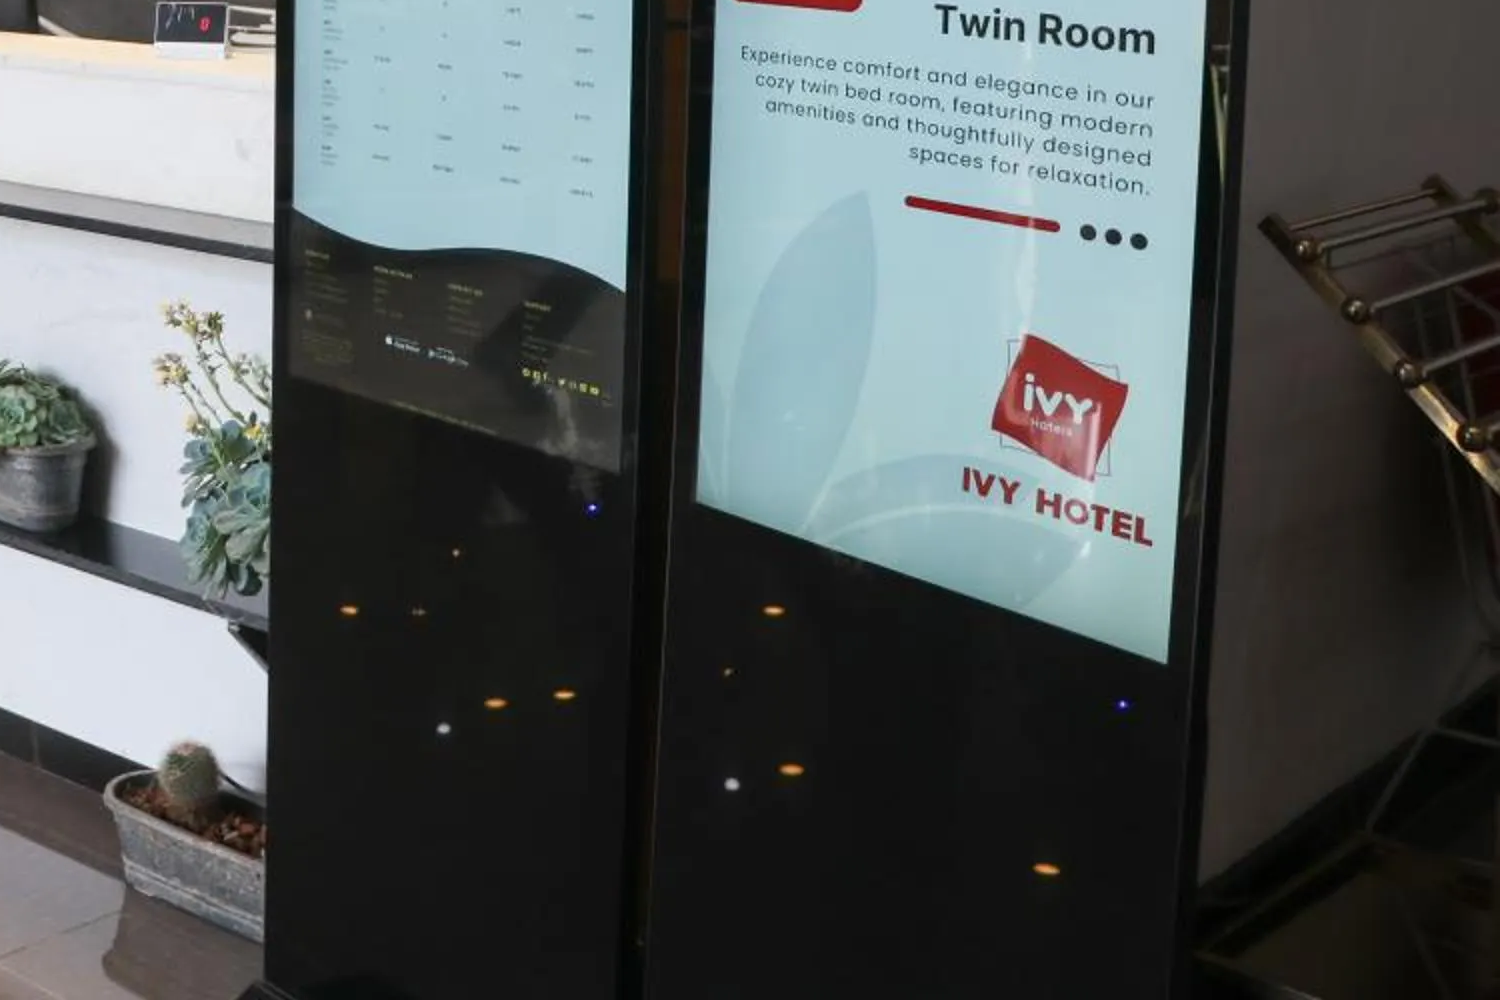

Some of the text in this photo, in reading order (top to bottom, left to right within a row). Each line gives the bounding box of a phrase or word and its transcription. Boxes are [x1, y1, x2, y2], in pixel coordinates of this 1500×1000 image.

[934, 4, 1156, 55] Twin Room
[741, 45, 1154, 110] Experience comfort and elegance in our
[756, 74, 1153, 138] cozy twin bed room, featuring modern
[765, 100, 1151, 167] amenities and thoughtfully designed
[909, 147, 1150, 196] spaces for relaxation.
[962, 466, 1153, 547] IVY HOTEL
